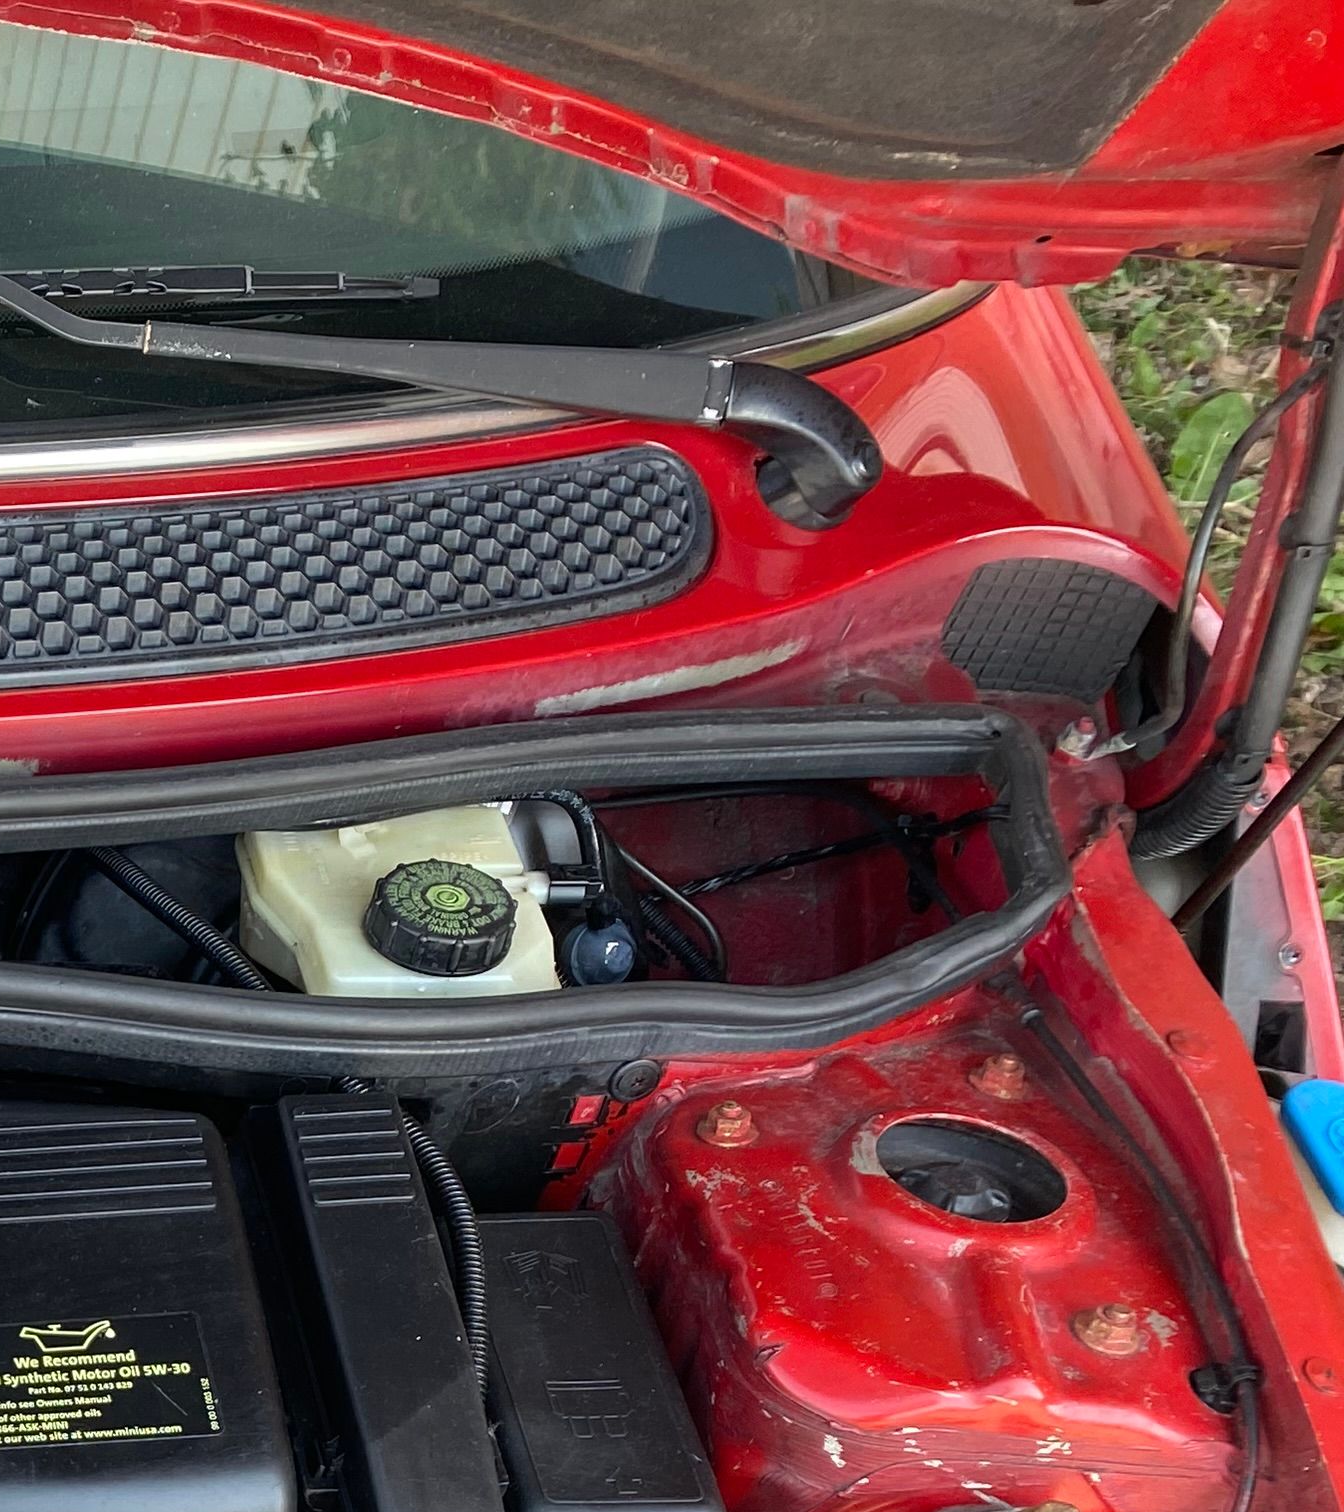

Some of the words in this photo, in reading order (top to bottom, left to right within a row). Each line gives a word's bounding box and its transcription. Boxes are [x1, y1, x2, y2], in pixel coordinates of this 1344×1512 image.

[13, 1357, 39, 1369] We
[42, 1349, 136, 1367] Recommend
[3, 1371, 69, 1388] Synthetic
[72, 1369, 117, 1380] Motor
[119, 1365, 140, 1378] Oil
[143, 1362, 191, 1376] 5W-30
[28, 1386, 46, 1395] Part
[36, 1398, 73, 1407] Owners
[74, 1394, 112, 1405] Manual
[9, 1413, 36, 1422] other
[37, 1409, 82, 1421] approved
[24, 1433, 47, 1442] web
[49, 1431, 69, 1441] site
[71, 1430, 82, 1439] at
[83, 1425, 182, 1439] www.miniusa.com
